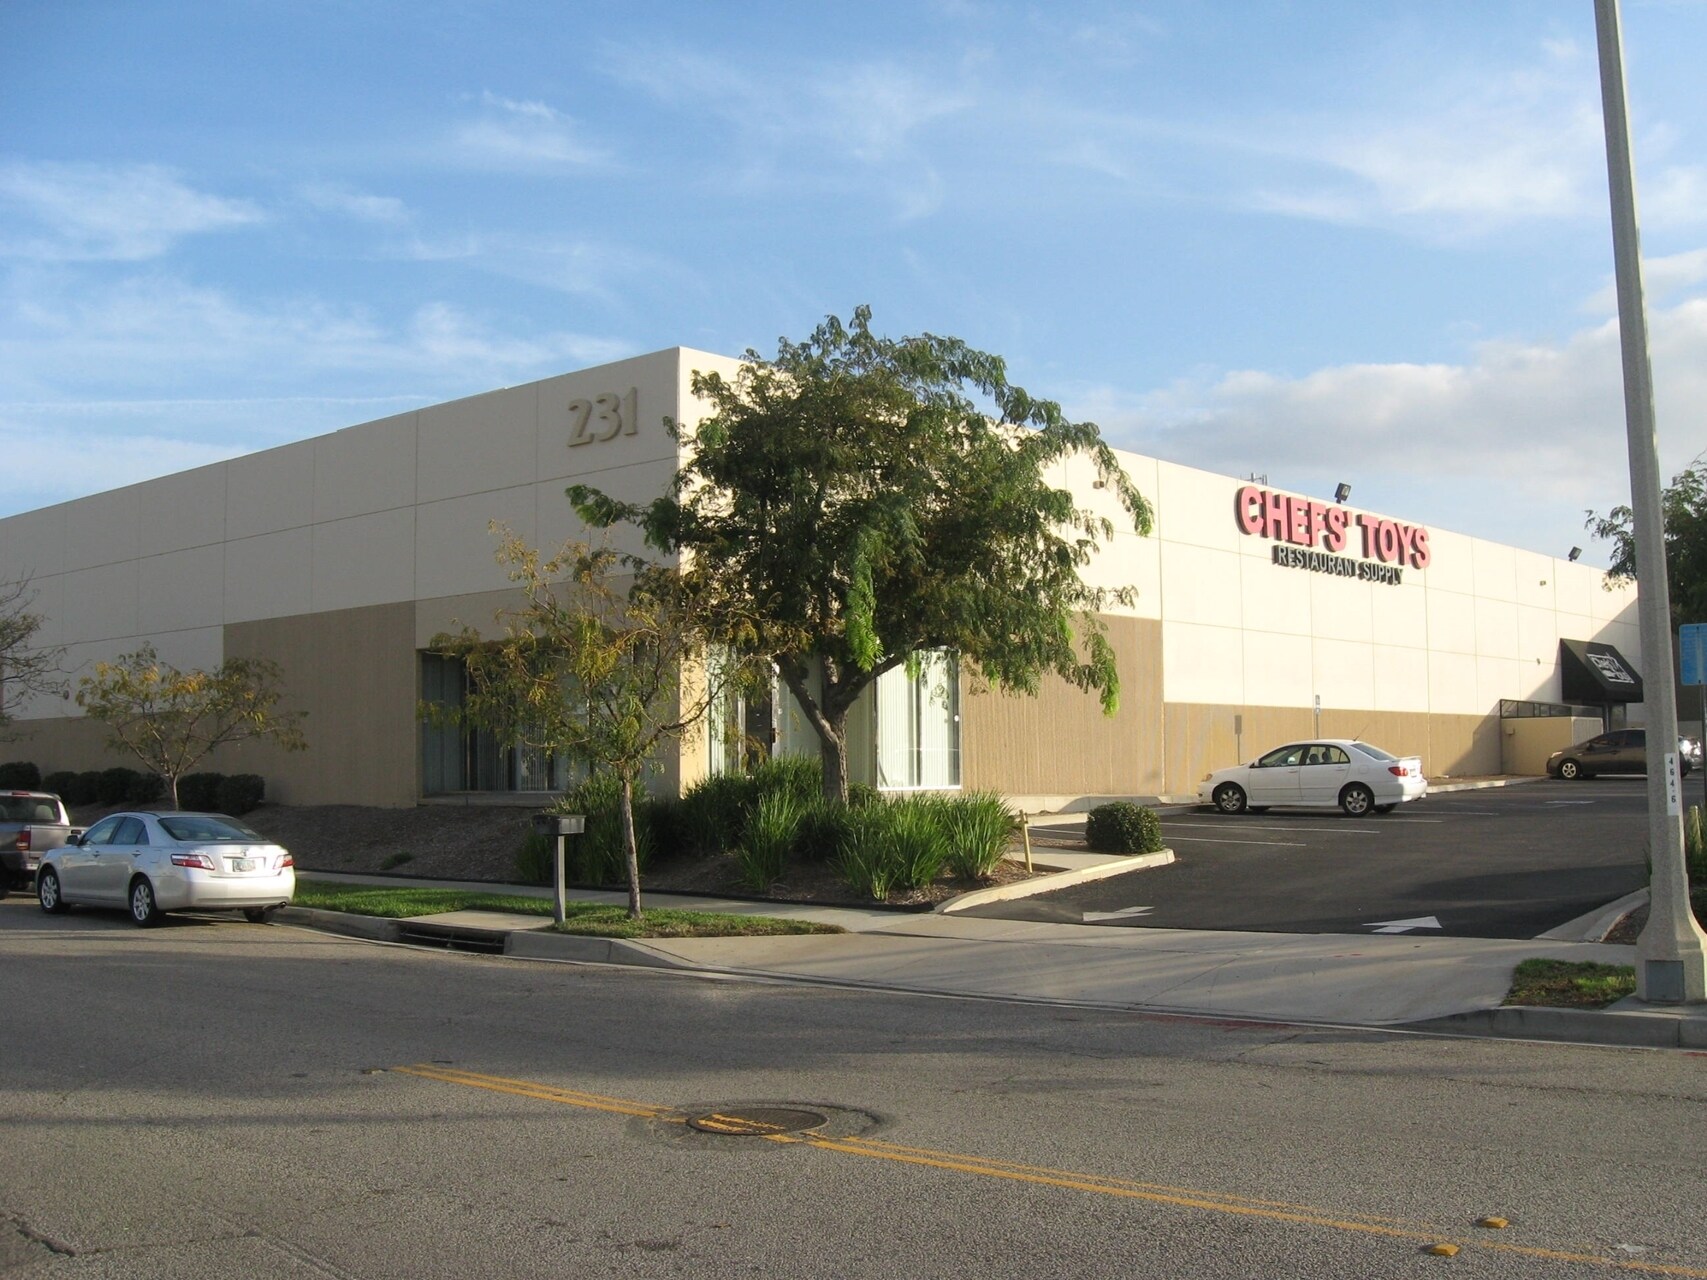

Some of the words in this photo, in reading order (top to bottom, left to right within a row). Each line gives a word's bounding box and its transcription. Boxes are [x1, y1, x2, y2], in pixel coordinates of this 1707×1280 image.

[567, 387, 638, 447] 231
[1235, 486, 1352, 552] CHEFS'
[1357, 513, 1431, 569] TOYS
[1272, 545, 1357, 578] RESTAURANT
[1358, 561, 1403, 585] SUPPLY
